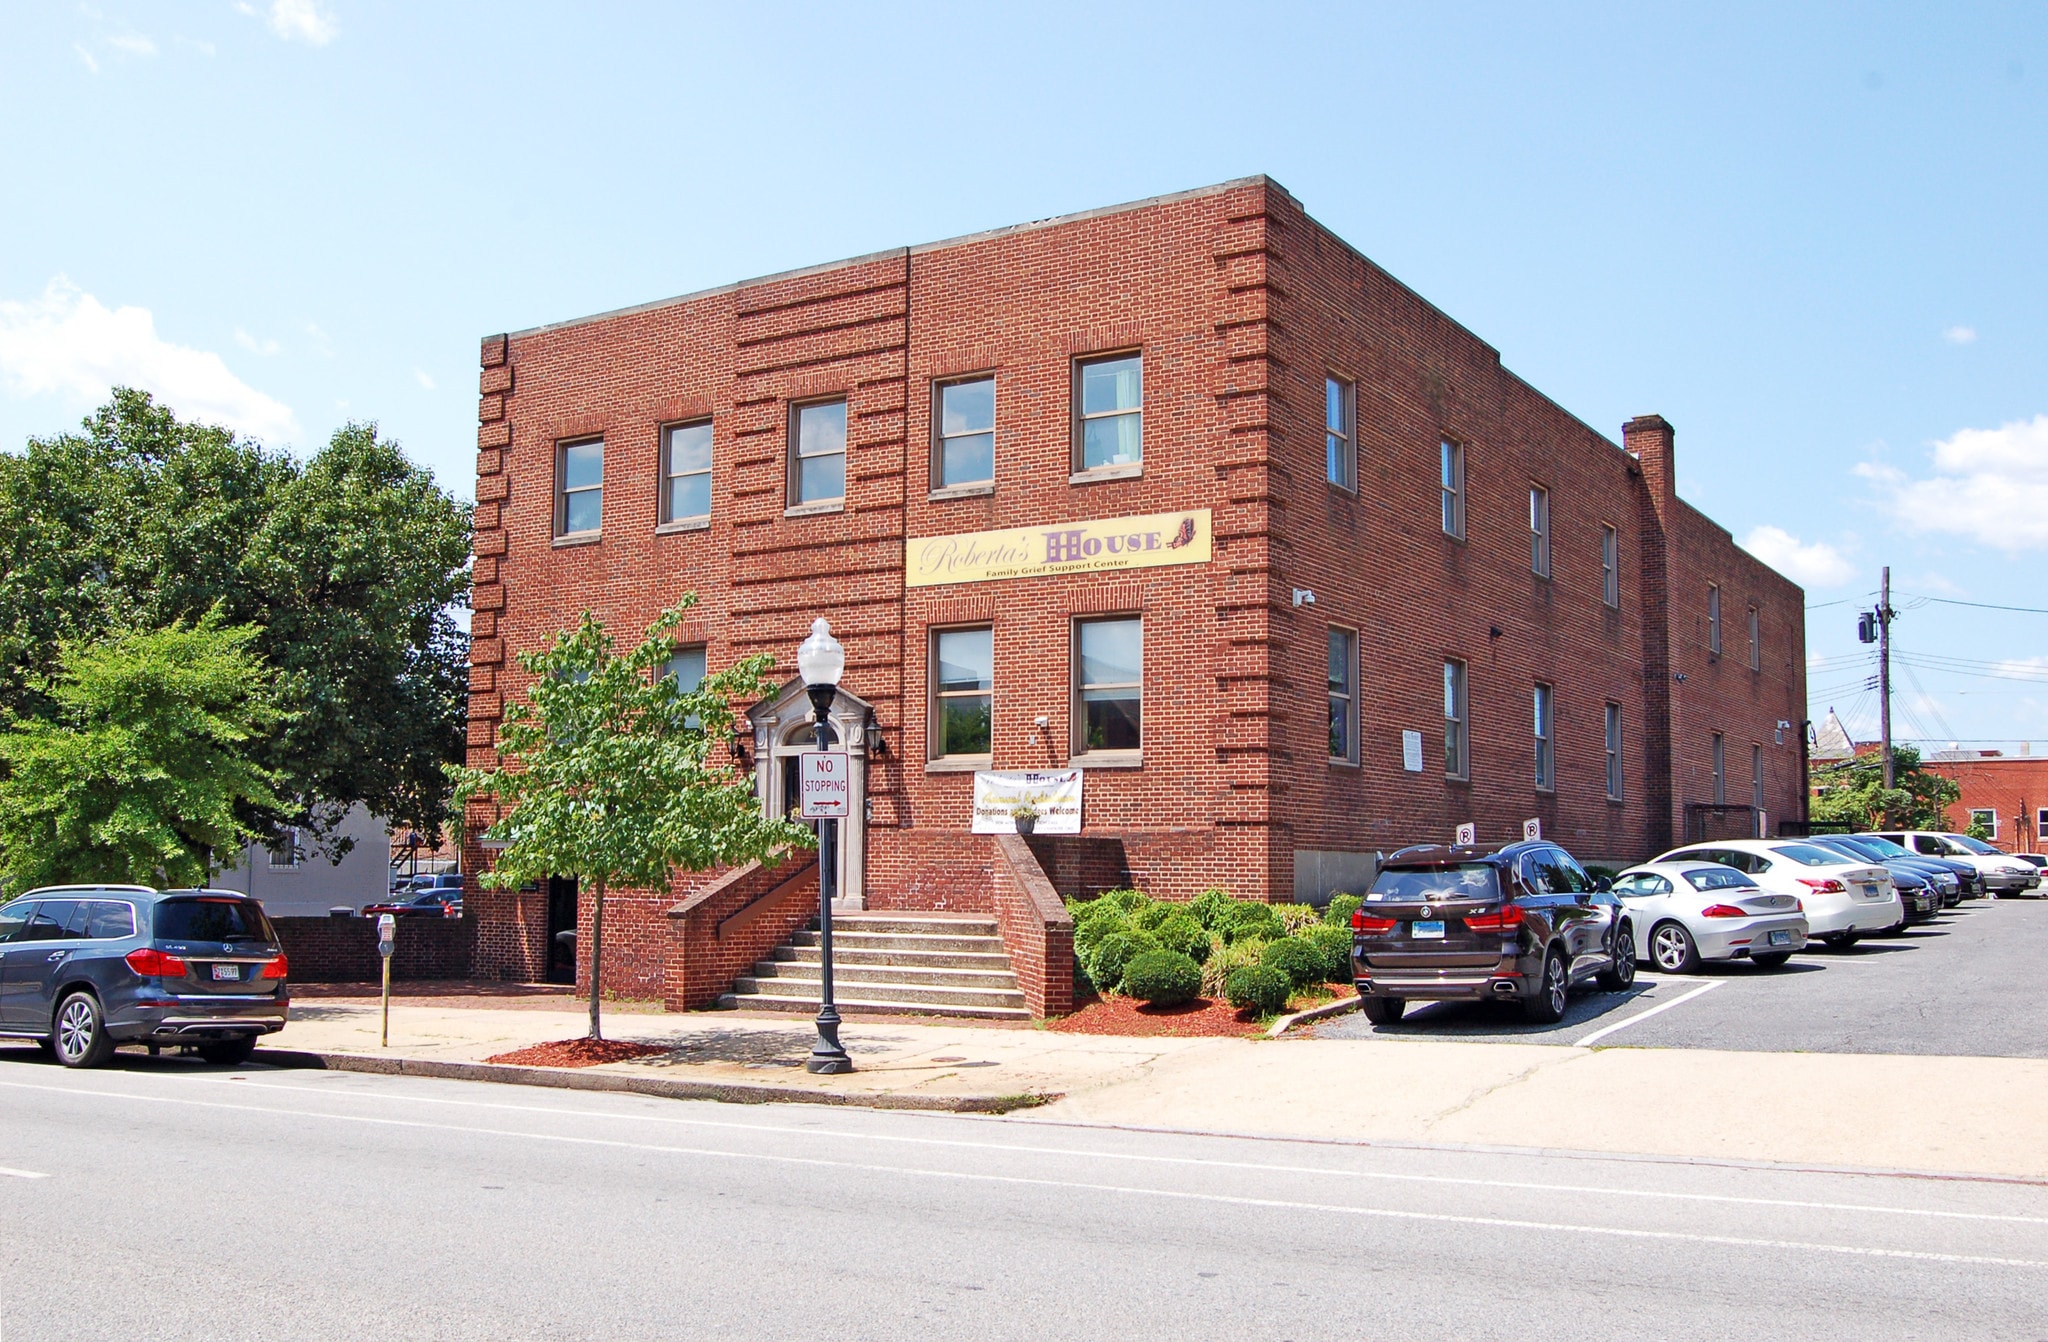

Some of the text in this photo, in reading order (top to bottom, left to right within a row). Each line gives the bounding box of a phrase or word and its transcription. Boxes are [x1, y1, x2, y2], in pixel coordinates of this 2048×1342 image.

[920, 529, 1163, 575] Roberta's HOUSE
[986, 560, 1129, 577] Family Grief Support Center
[816, 760, 833, 772] NO
[805, 780, 846, 792] STOPPING
[976, 807, 1008, 816] Donations
[1049, 806, 1080, 816] Welcome
